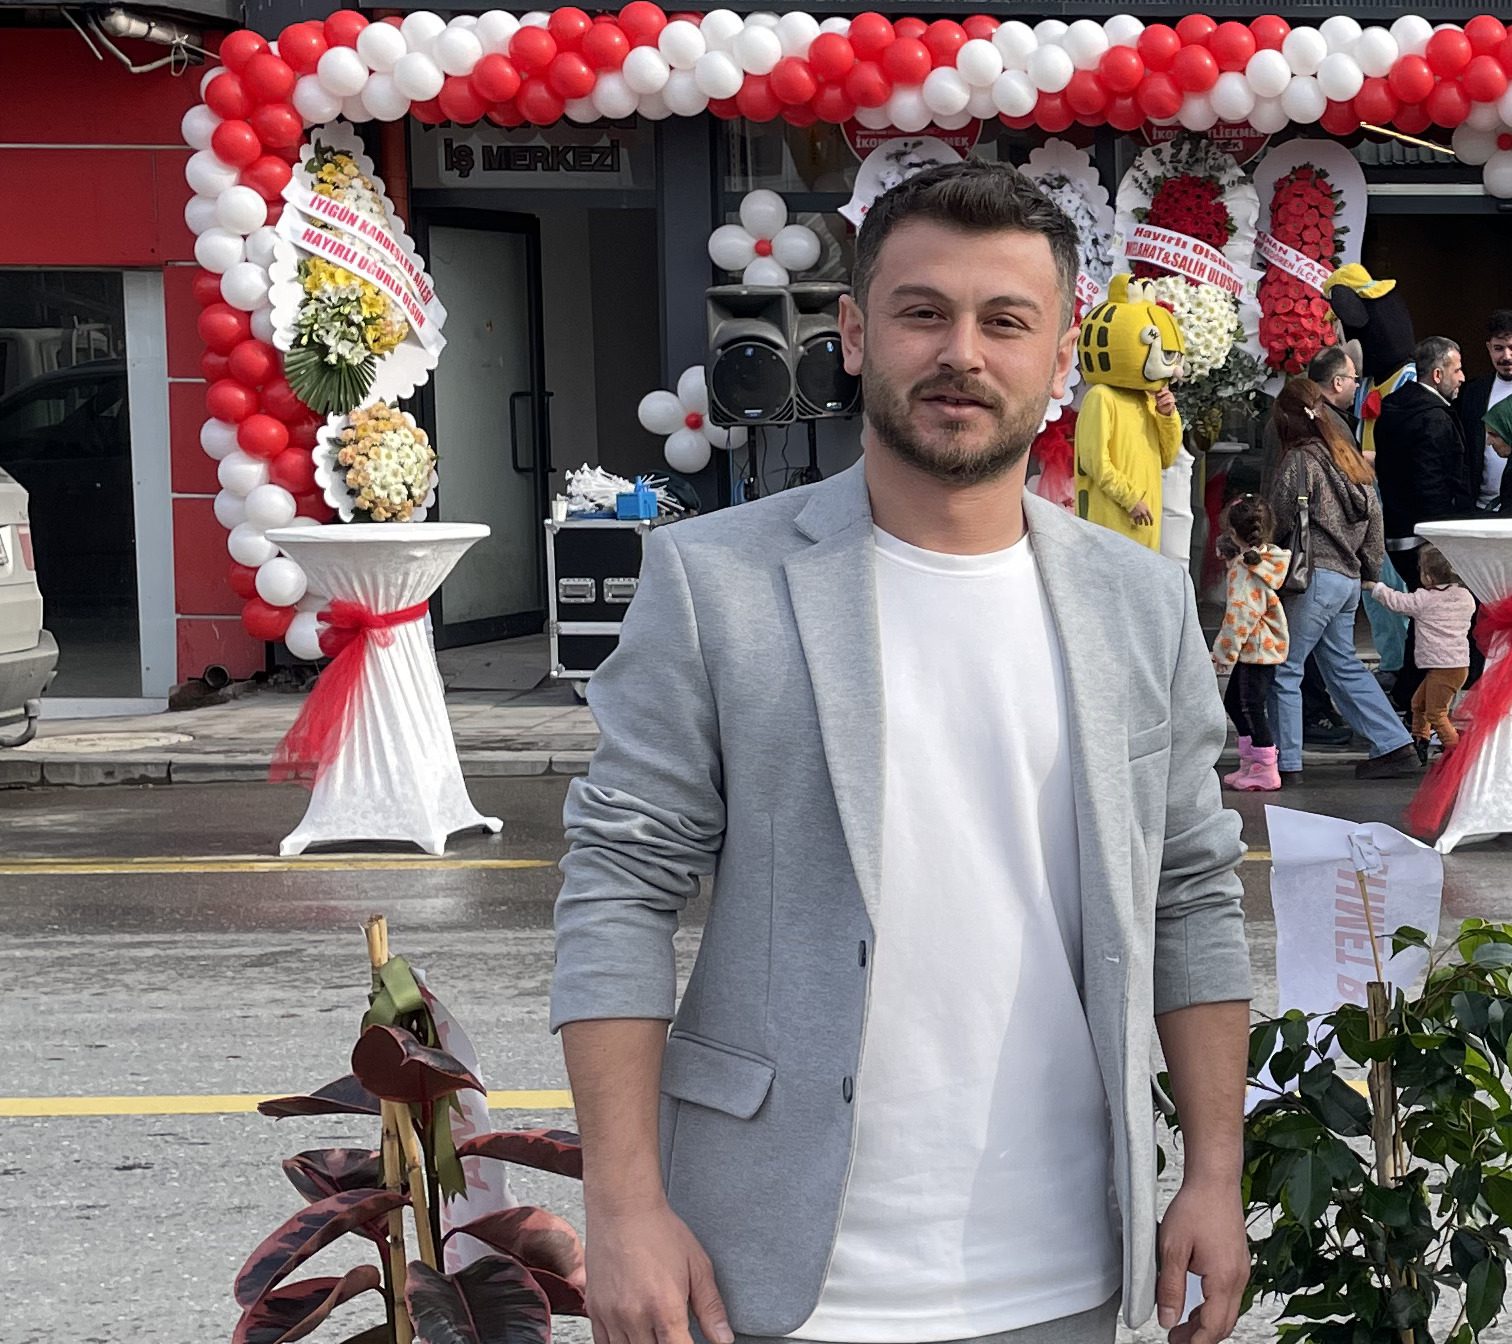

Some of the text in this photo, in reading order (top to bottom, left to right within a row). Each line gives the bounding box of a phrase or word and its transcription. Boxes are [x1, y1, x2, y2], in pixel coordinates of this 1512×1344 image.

[444, 138, 620, 178] İŞ MERKEZİ
[309, 194, 359, 227] İYİGÜN
[358, 219, 415, 277] KARDEŞLER
[1133, 227, 1187, 250] Hayırlı
[301, 227, 426, 329] HAYIRLI UĞURLU OLSUN
[1207, 266, 1244, 298] ULUSOY
